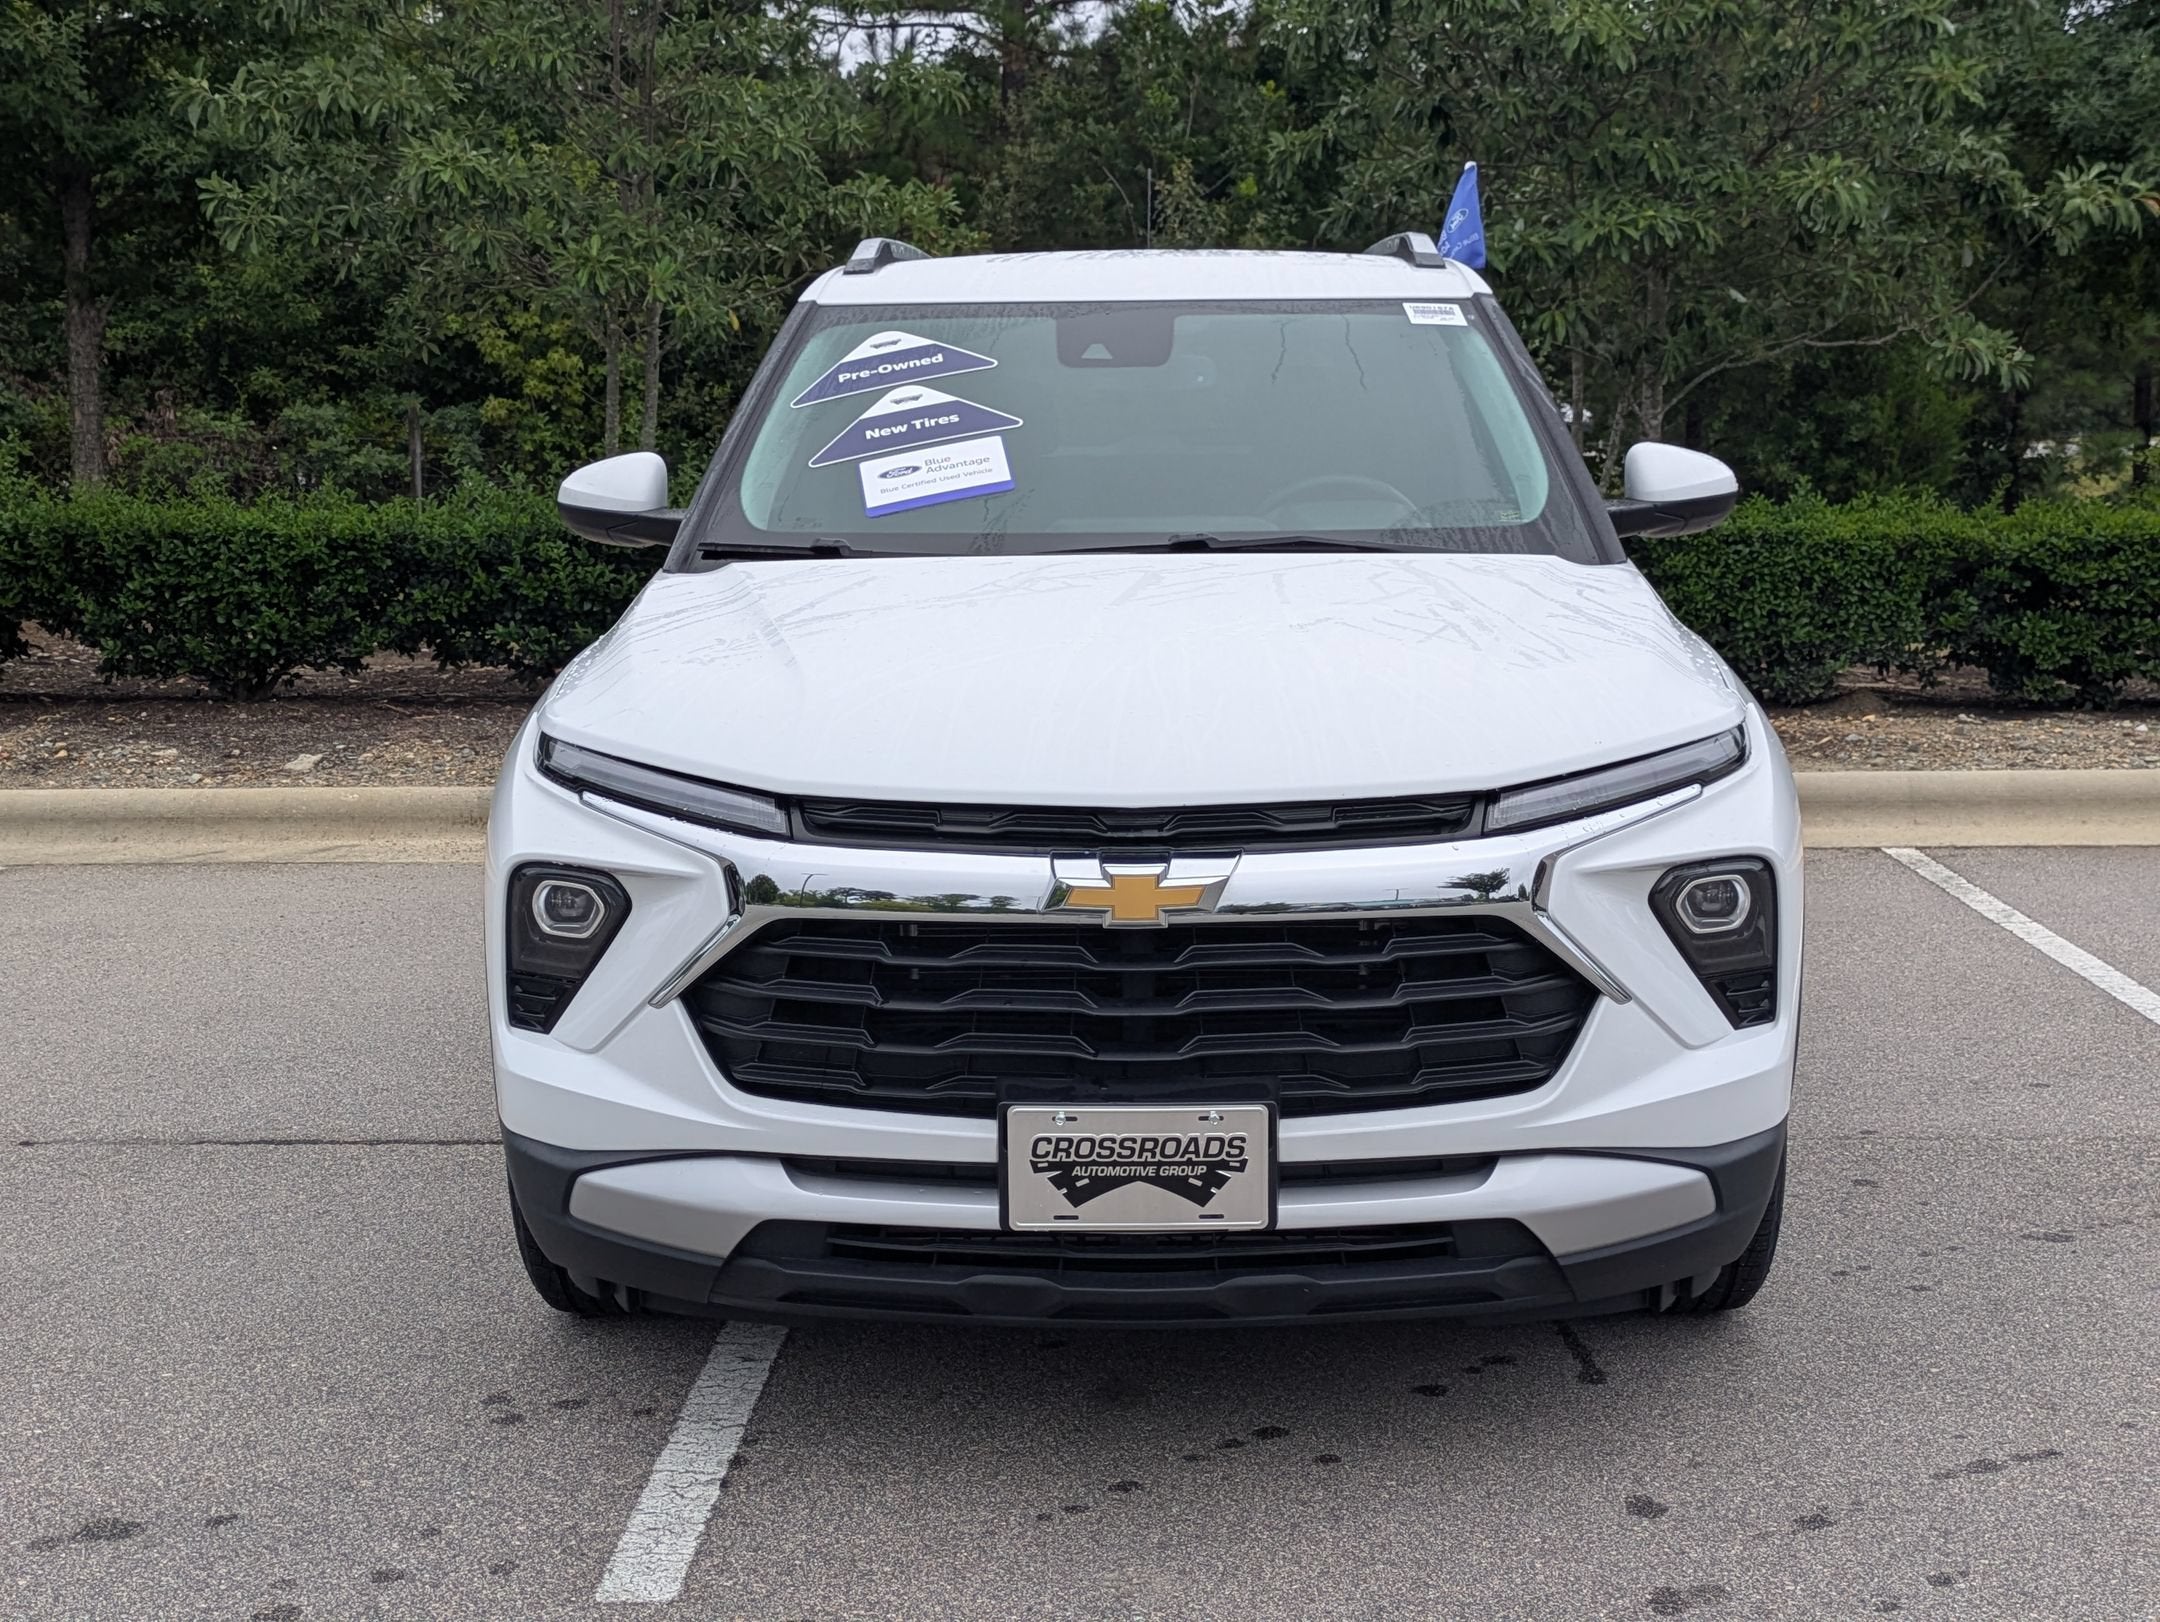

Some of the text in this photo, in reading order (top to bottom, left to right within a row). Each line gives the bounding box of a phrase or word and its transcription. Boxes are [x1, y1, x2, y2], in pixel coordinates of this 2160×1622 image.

[838, 353, 944, 383] Pre-Owned
[865, 414, 960, 440] New Tires
[924, 456, 951, 467] Blue
[926, 456, 991, 474] Advantage
[880, 467, 993, 494] Blue Certified Used Vehicle
[886, 467, 913, 479] Ford
[1031, 1136, 1247, 1160] CROSSROADS
[1071, 1165, 1207, 1177] AUTOMOTIVE GROUP
